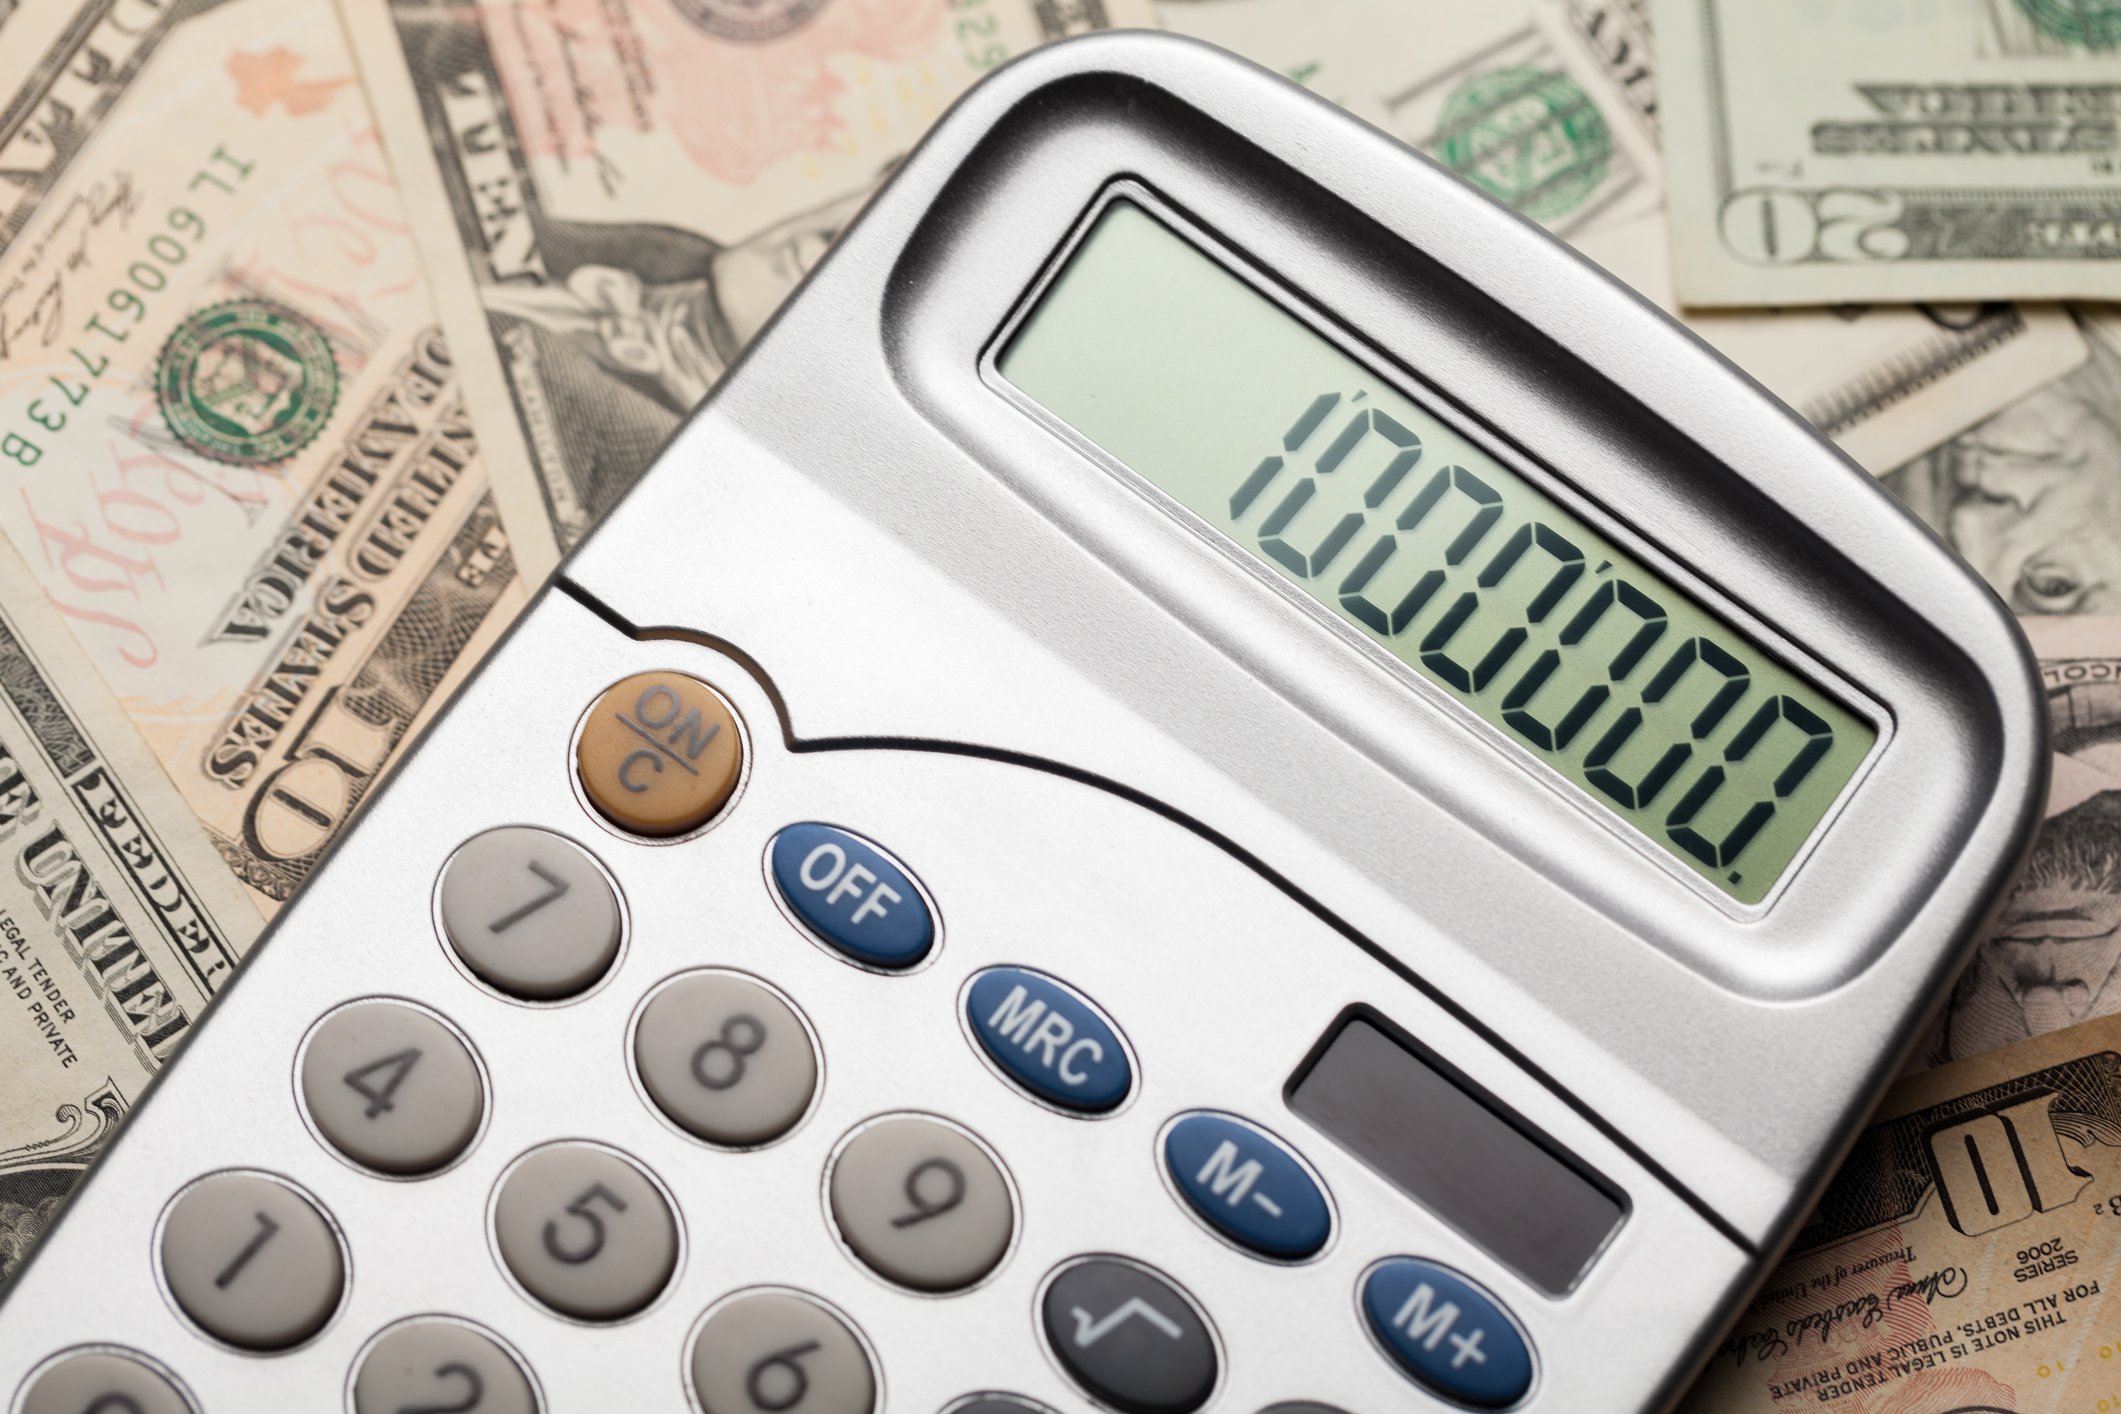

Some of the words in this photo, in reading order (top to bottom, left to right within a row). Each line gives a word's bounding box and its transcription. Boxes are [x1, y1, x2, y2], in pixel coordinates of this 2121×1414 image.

[188, 145, 254, 199] IL
[1719, 186, 1909, 265] 20
[28, 207, 206, 432] 60061773
[0, 431, 42, 467] B
[195, 395, 432, 650] AMERICA
[346, 410, 492, 577] NITED
[453, 523, 513, 592] TE
[203, 580, 376, 790] STATES
[2044, 663, 2121, 683] COL
[634, 685, 720, 760] ON
[240, 684, 392, 864] 10
[617, 750, 664, 793] C
[80, 780, 237, 986] FEDER
[489, 860, 571, 934] 7
[799, 842, 902, 924] OFF
[1, 964, 34, 1003] AND
[25, 1001, 80, 1070] PRIVATE
[24, 957, 78, 1025] TENDER
[690, 1014, 767, 1091] 8
[987, 985, 1104, 1085] MRC
[344, 1048, 423, 1121] 4
[890, 1158, 966, 1229] 9
[1195, 1140, 1283, 1218] M-
[1920, 1086, 2095, 1238] 10
[213, 1210, 280, 1290] 1
[543, 1184, 628, 1265] 5
[2015, 1237, 2065, 1265] 2006
[1809, 1273, 1833, 1293] the
[1829, 1265, 1850, 1286] of
[1849, 1245, 1917, 1280] Treasurer
[2011, 1249, 2080, 1283] SERIES
[2062, 1280, 2101, 1305] FOR
[1392, 1283, 1488, 1369] M+
[1970, 1325, 2021, 1353] NOTE
[2021, 1309, 2067, 1336] THIS
[2022, 1294, 2060, 1318] ALL
[746, 1341, 821, 1411] 6
[1844, 1353, 1883, 1377] AND
[1885, 1329, 1954, 1363] PUBLIC
[1887, 1349, 1947, 1380] LEGAL
[1949, 1342, 1969, 1360] IS
[1768, 1367, 1842, 1401] PRIVATE
[1815, 1369, 1887, 1403] TENDER
